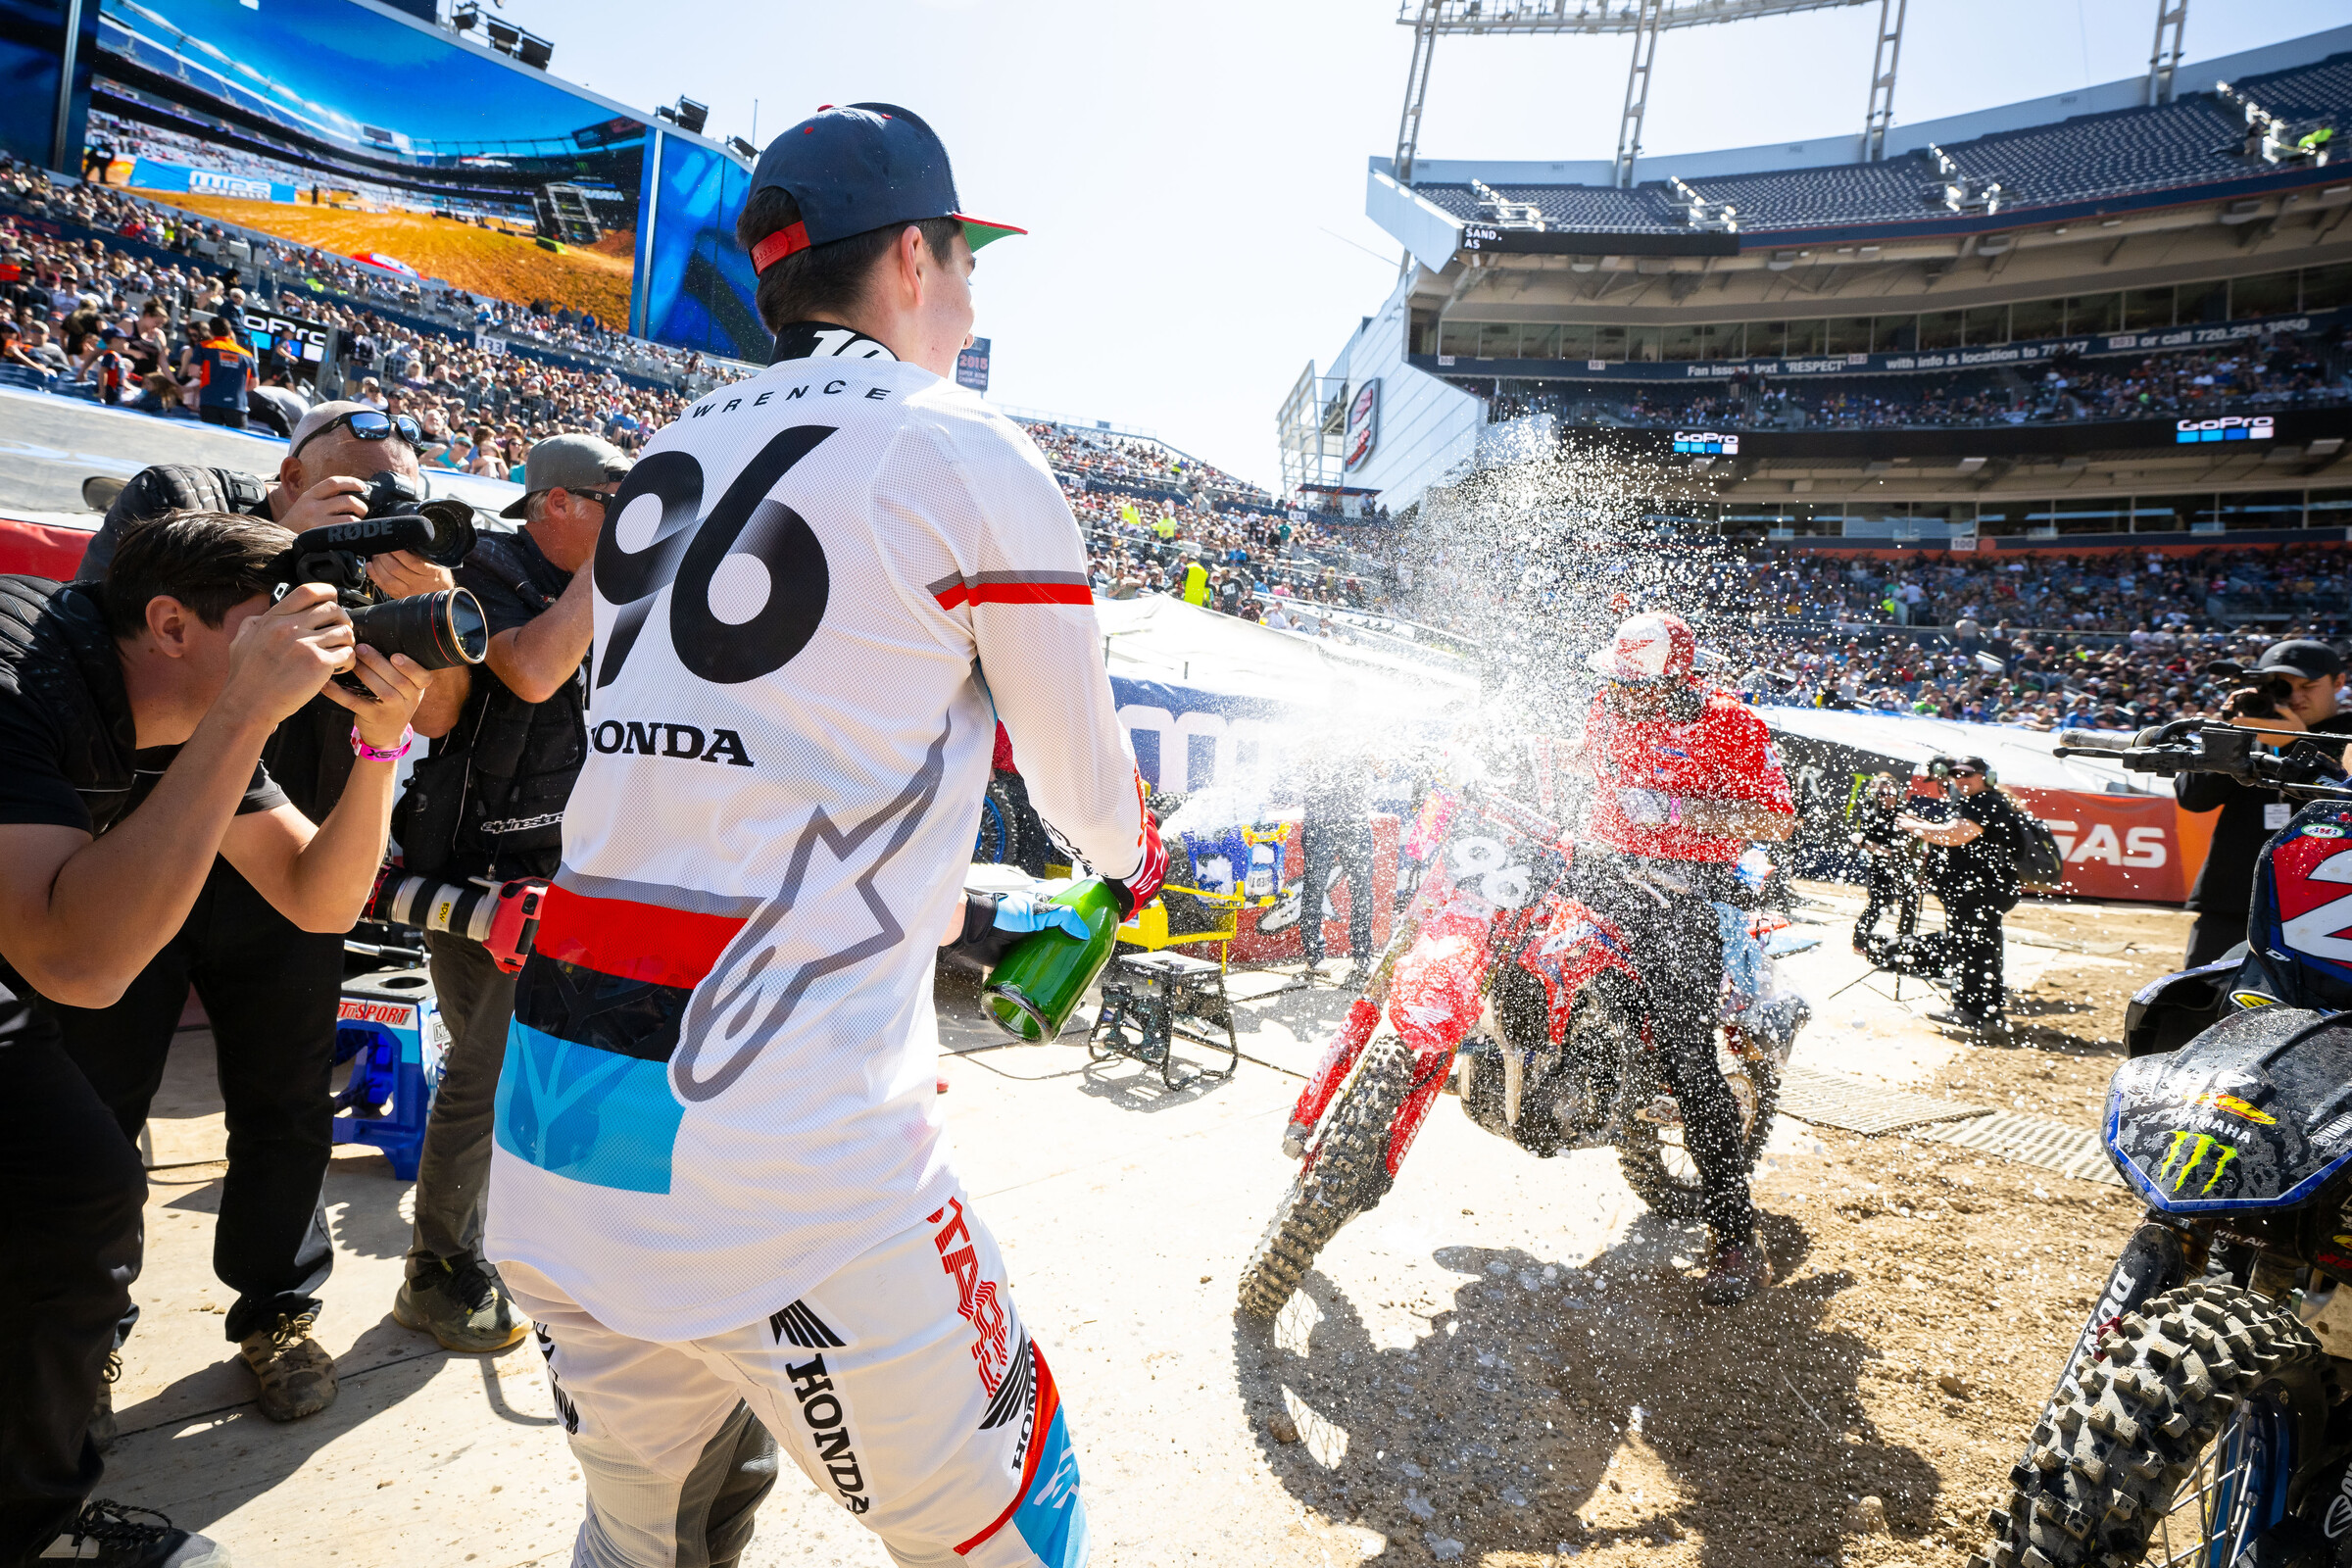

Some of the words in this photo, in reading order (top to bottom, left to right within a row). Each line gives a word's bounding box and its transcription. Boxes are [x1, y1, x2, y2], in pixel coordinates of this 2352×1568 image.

[1465, 227, 1502, 241] SAND.
[1465, 238, 1481, 250] AS
[243, 315, 327, 347] oPro
[2140, 336, 2157, 348] or
[2162, 330, 2191, 345] call
[479, 338, 503, 354] 133
[958, 354, 989, 370] 2015
[1886, 358, 1914, 369] with
[1917, 356, 1943, 368] info
[1946, 354, 1958, 366] &
[1961, 349, 2019, 365] location
[2023, 347, 2038, 359] to
[1688, 366, 1708, 376] Fan
[675, 380, 891, 421] WRENCE
[2177, 416, 2275, 431] GoPro
[1674, 431, 1740, 444] GoPro
[327, 518, 394, 543] RØDE
[593, 424, 840, 690] 96
[589, 719, 755, 768] ONDA
[1452, 836, 1533, 909] 96
[1395, 1090, 1435, 1167] DUNLOP
[2181, 1113, 2252, 1145] AMAHA
[785, 1352, 870, 1515] HONDA
